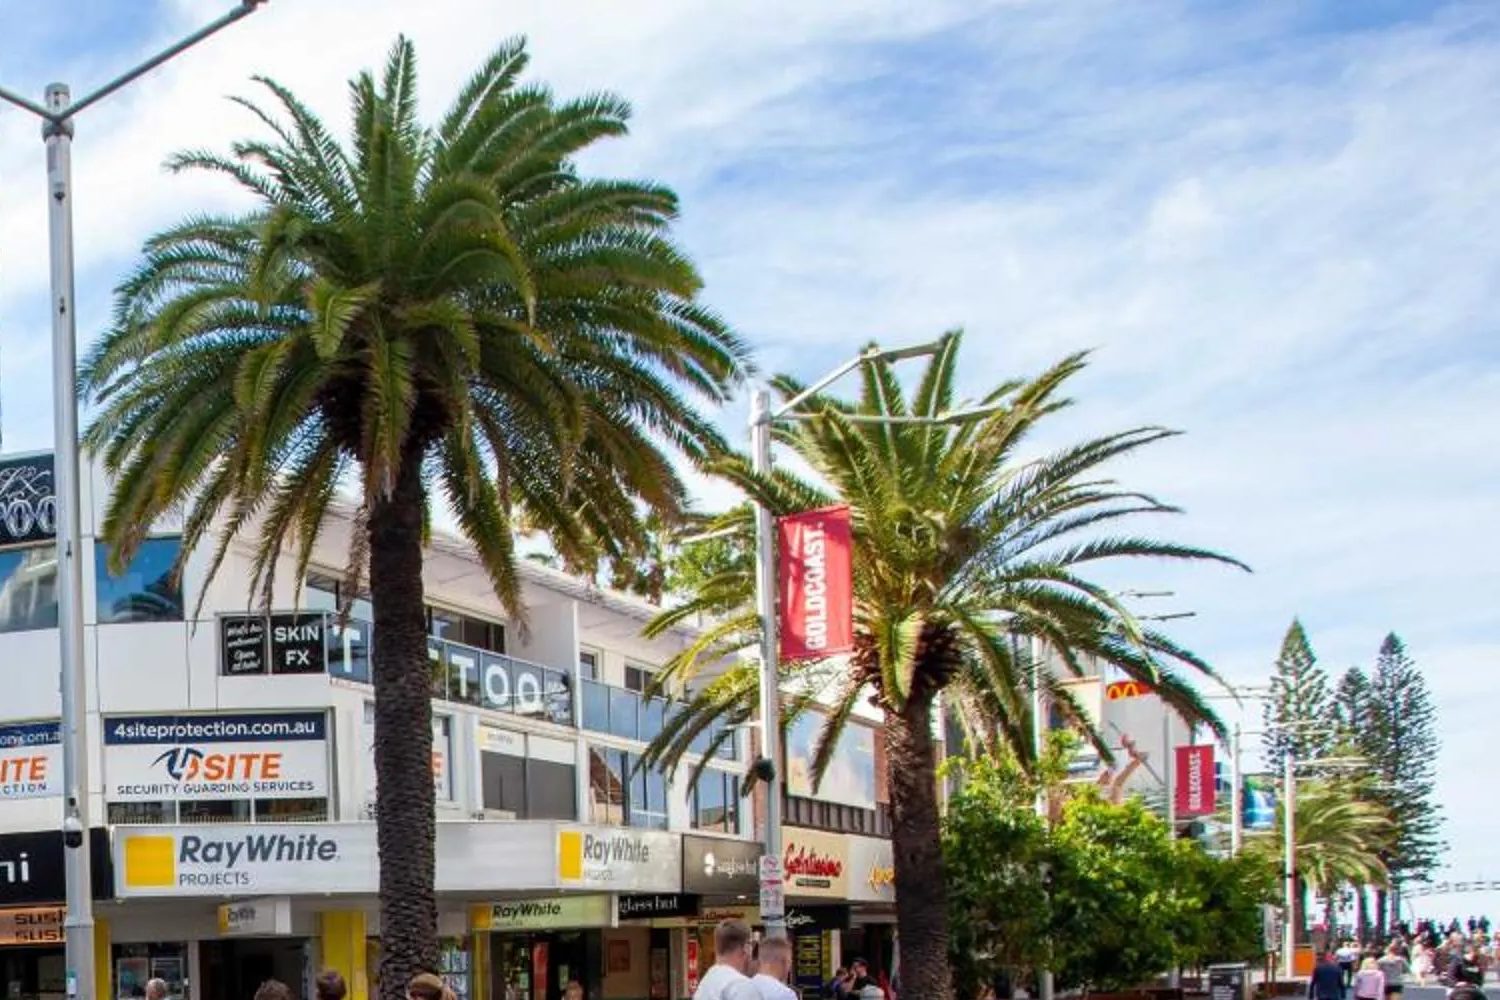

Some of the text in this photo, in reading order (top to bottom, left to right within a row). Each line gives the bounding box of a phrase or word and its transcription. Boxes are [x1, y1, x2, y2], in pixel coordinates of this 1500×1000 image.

[274, 625, 320, 643] SKIN
[286, 650, 311, 666] FX
[114, 720, 315, 740] 4siteprotection.com.au
[117, 780, 315, 795] SECURITY GUARDING SERVICES
[179, 872, 250, 886] PROJECTS
